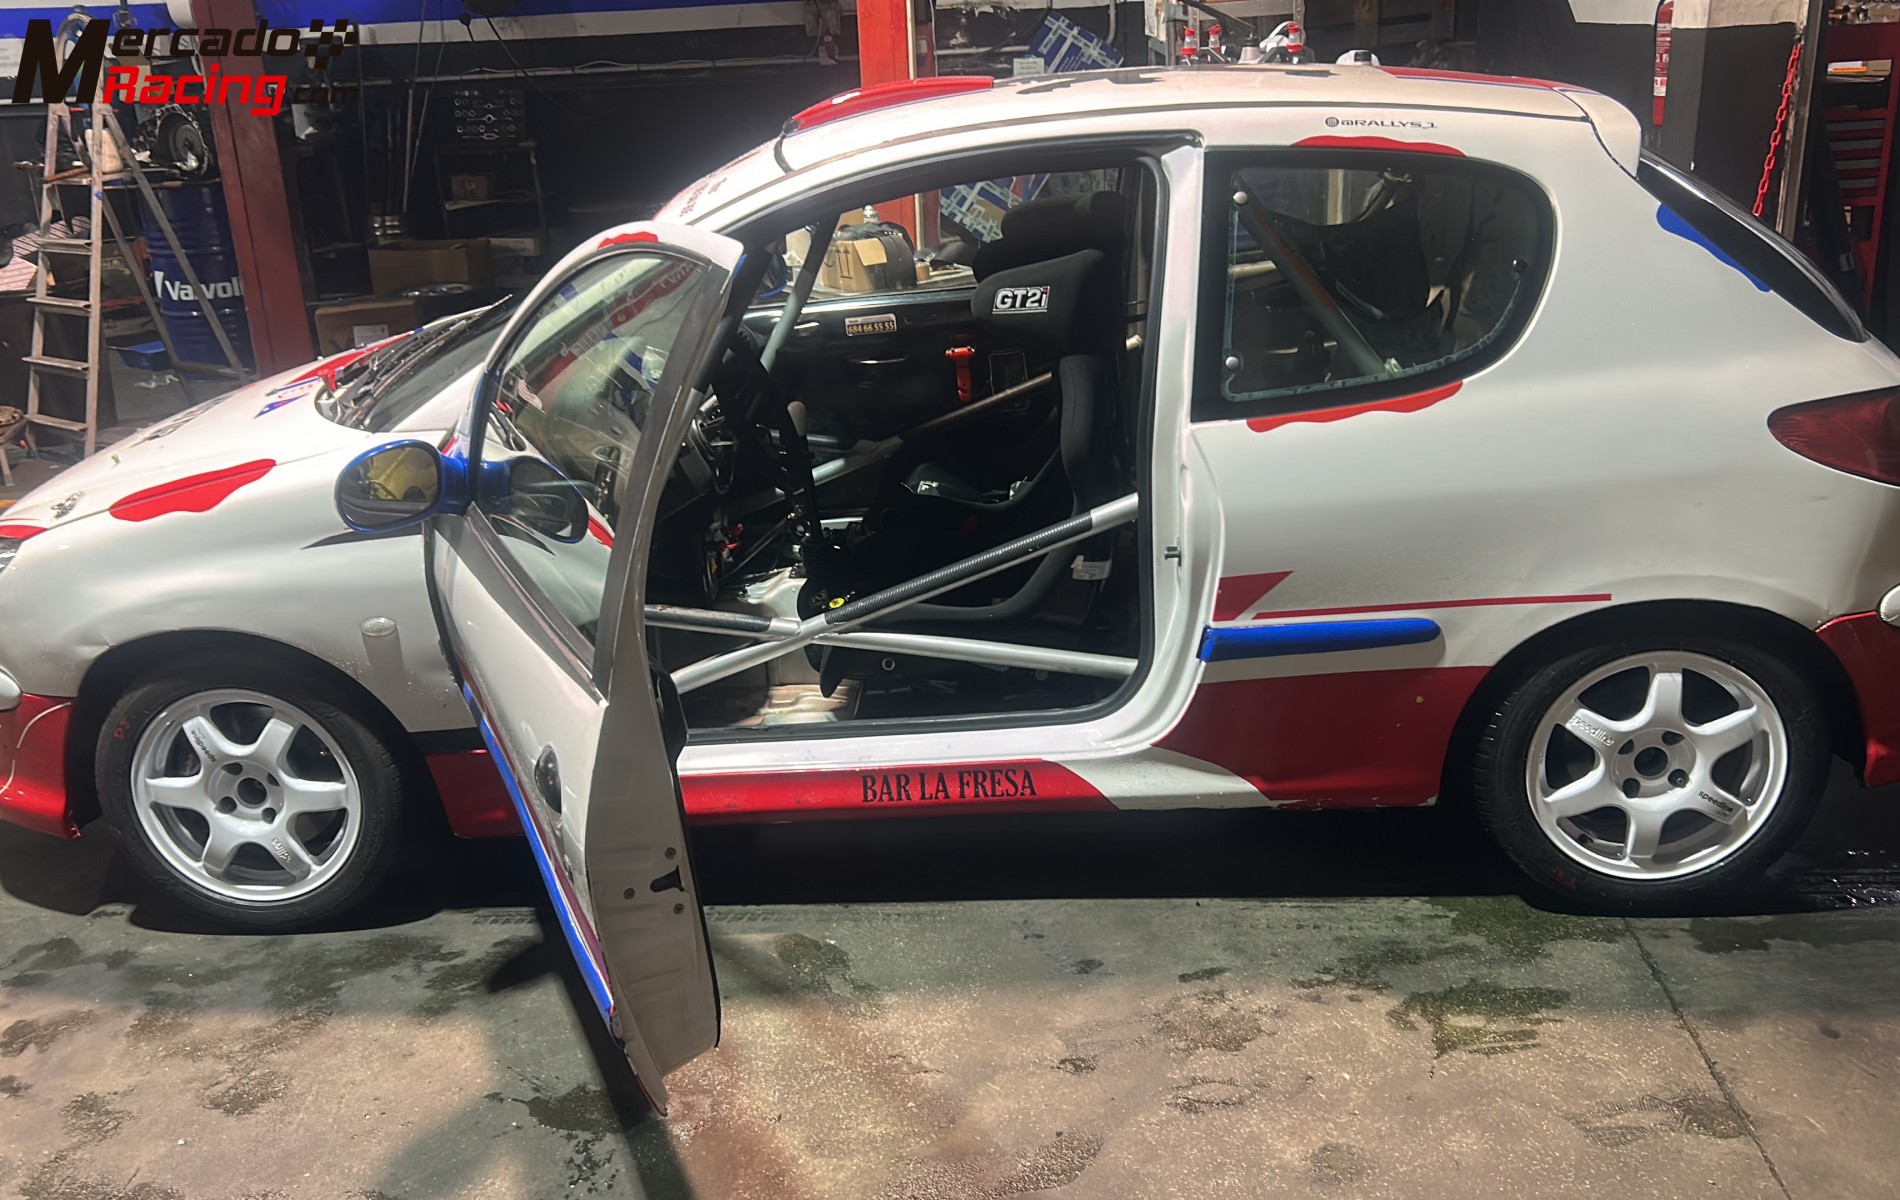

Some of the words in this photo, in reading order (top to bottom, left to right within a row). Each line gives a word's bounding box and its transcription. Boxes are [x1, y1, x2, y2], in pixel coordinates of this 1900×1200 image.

[996, 287, 1049, 309] GT2i
[861, 773, 912, 803] BAR
[918, 771, 951, 801] LA
[957, 769, 1037, 799] FRESA
